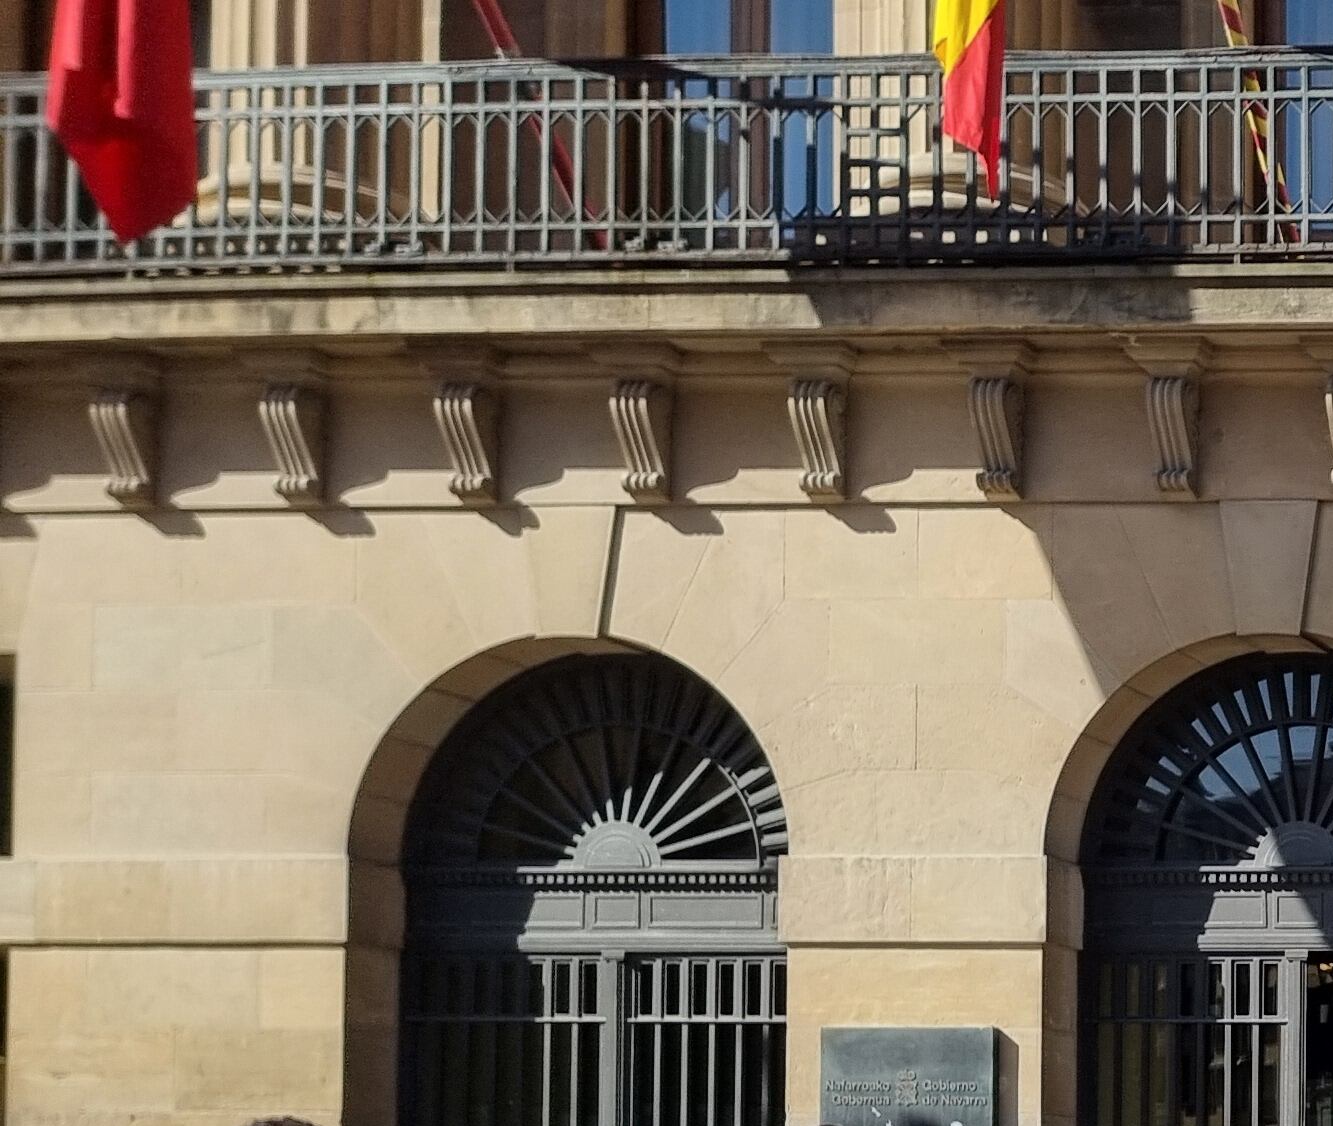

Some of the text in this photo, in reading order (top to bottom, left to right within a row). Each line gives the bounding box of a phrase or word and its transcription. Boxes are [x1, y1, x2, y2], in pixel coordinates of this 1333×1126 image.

[826, 1080, 891, 1091] Nafarroako
[922, 1080, 977, 1091] Gobierno
[922, 1094, 987, 1106] de Navarra
